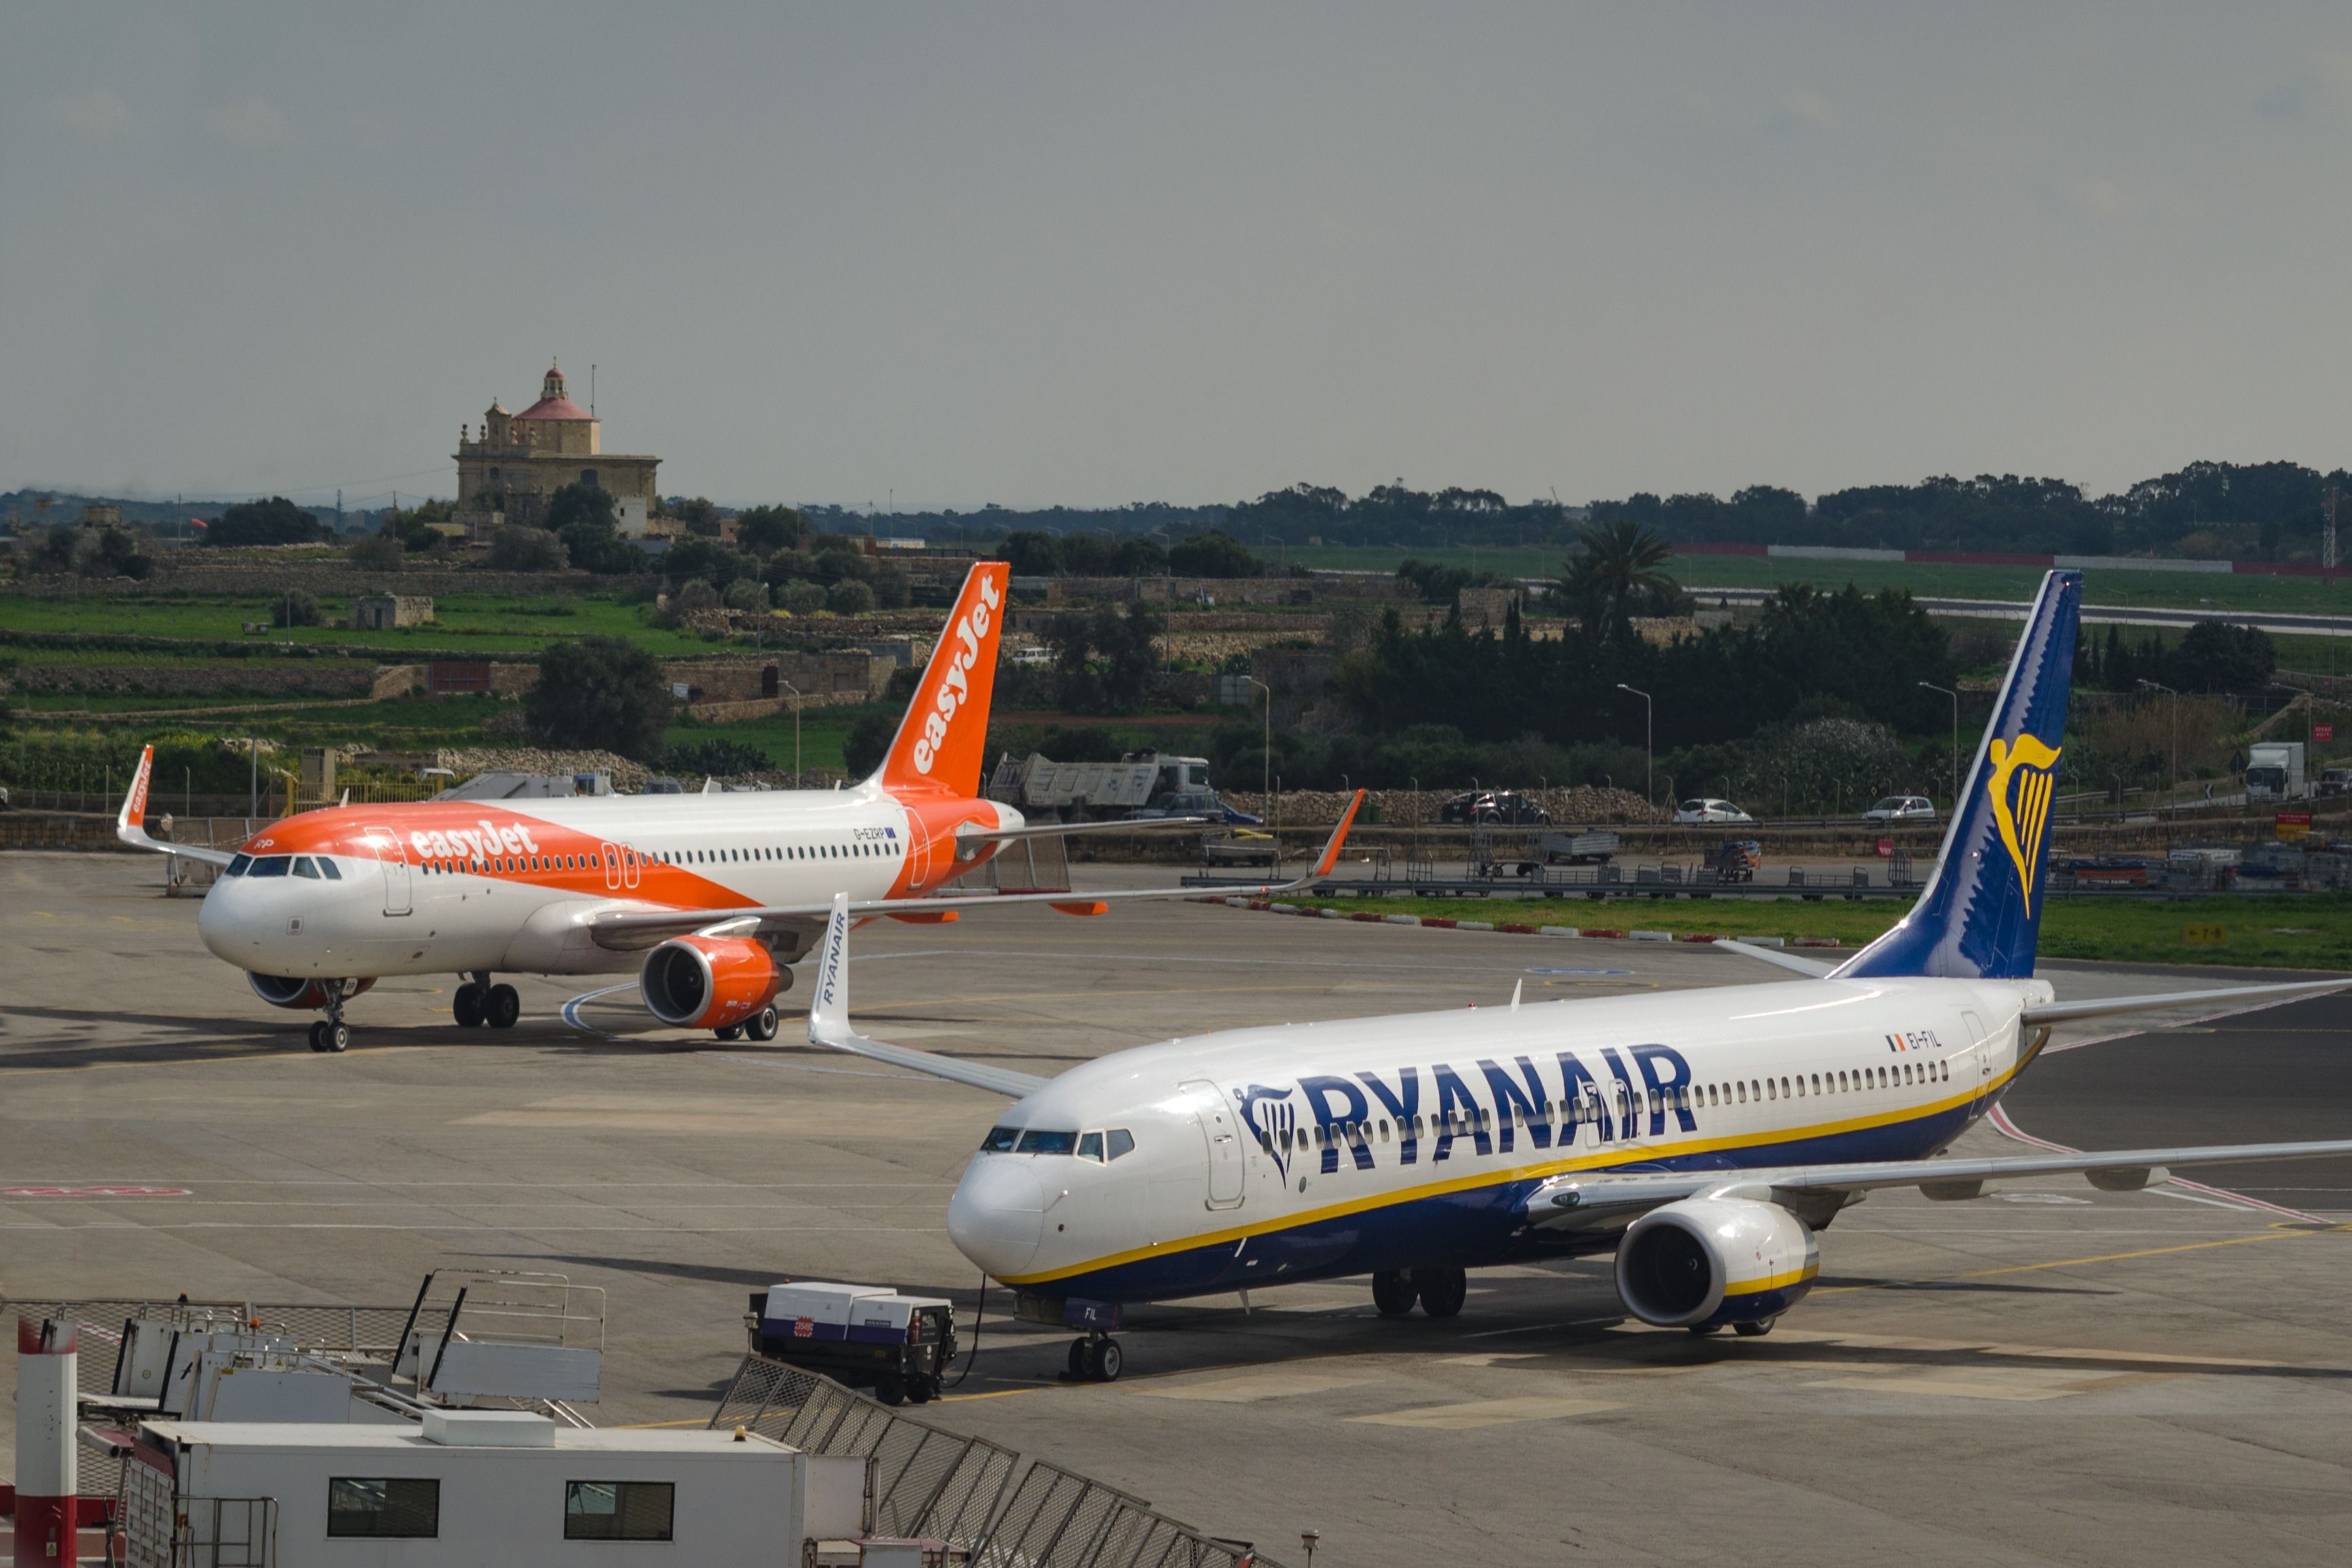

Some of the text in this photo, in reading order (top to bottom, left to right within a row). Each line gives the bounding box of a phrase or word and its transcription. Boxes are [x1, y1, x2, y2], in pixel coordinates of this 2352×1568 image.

[914, 574, 999, 774] easyJet
[133, 760, 151, 813] easyJet
[254, 839, 274, 849] RP
[410, 820, 538, 865] easyJet
[853, 827, 884, 840] G-EZRP
[823, 912, 845, 1005] RYANAIR
[1906, 1030, 1942, 1049] EI-FIL
[1296, 1043, 1698, 1174] RYANAIR
[1085, 1307, 1096, 1320] FIL
